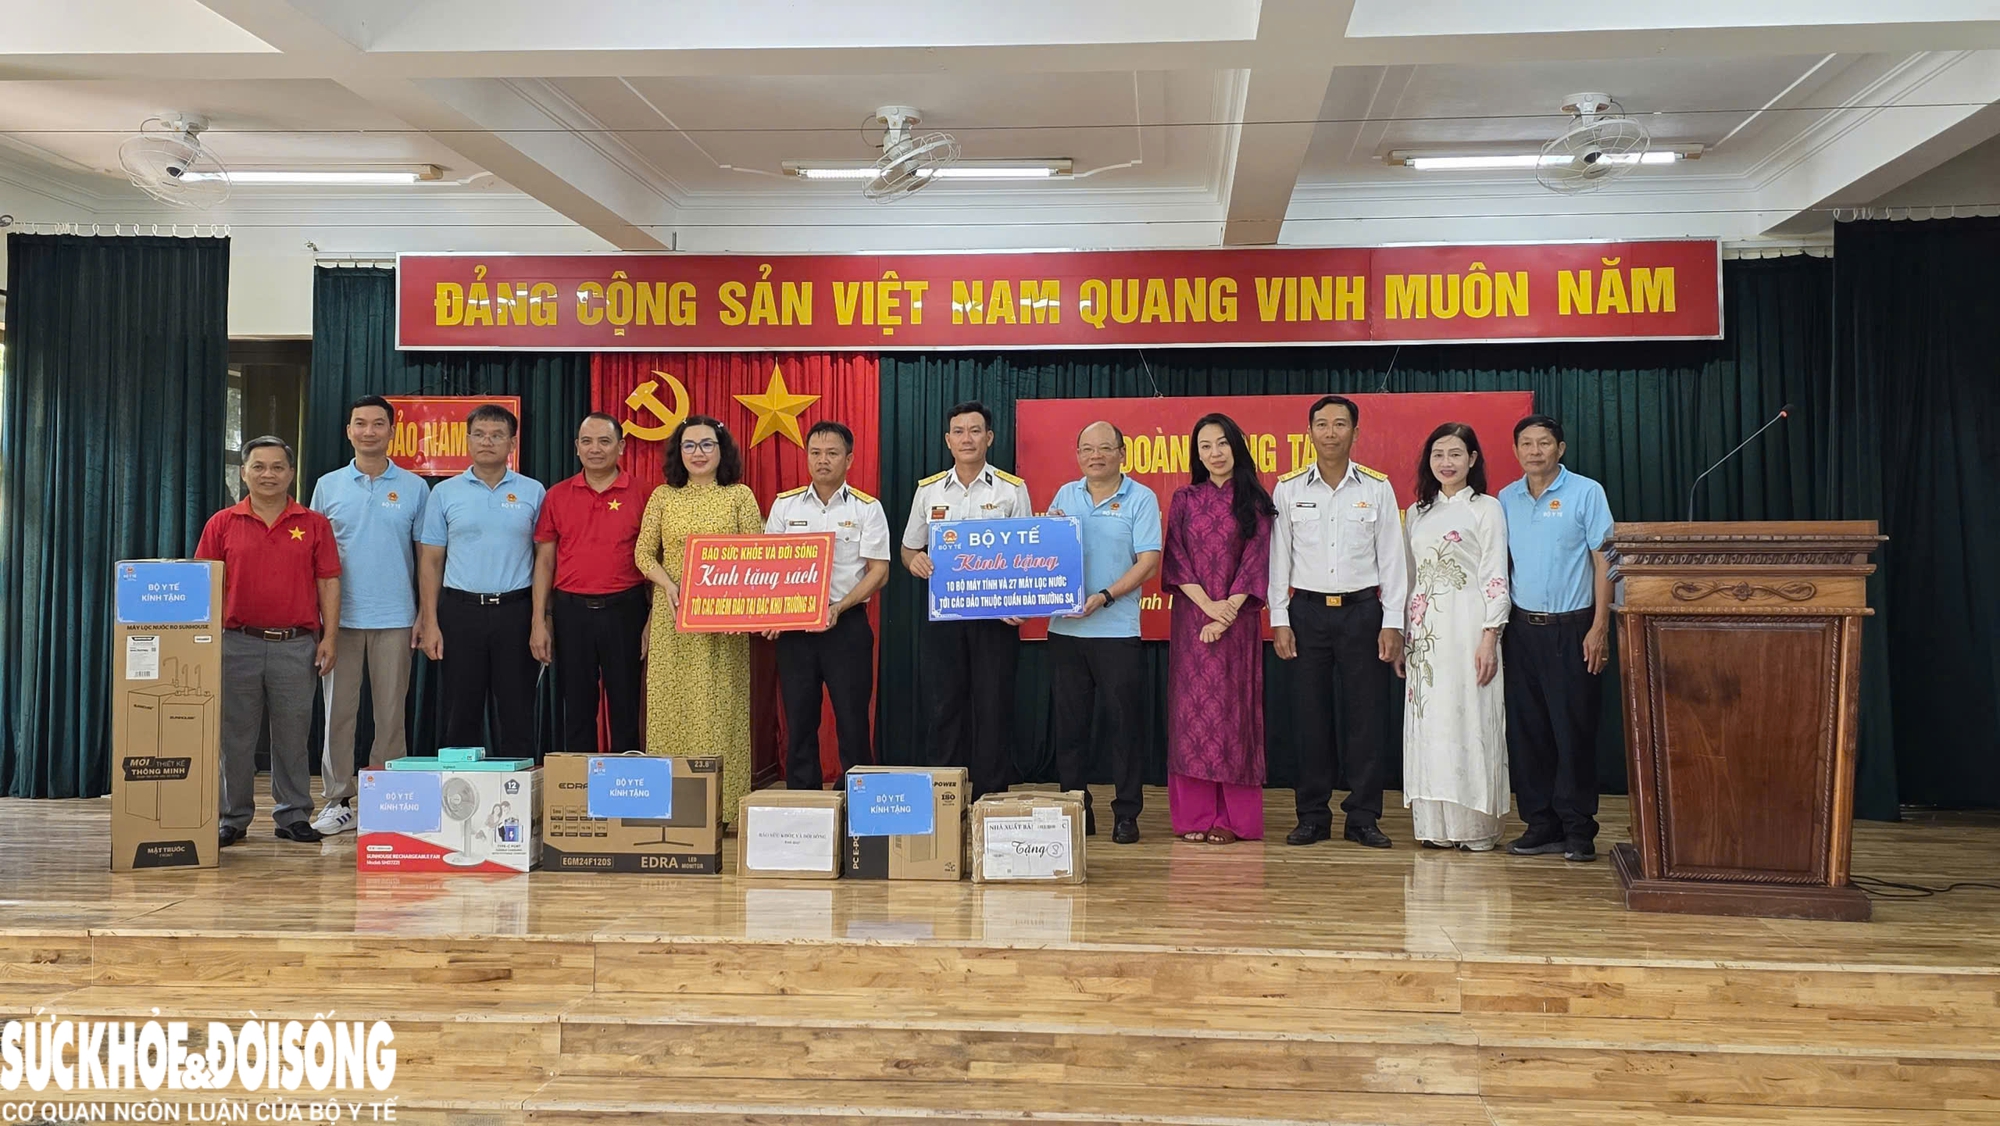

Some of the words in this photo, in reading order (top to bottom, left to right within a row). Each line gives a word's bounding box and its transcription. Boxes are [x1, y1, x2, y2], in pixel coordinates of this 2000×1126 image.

[434, 264, 558, 327] ĐẢNG
[575, 270, 697, 336] CỘNG
[719, 264, 825, 327] SẢN
[833, 270, 929, 336] VIỆT
[951, 280, 1061, 326] NAM
[1078, 277, 1238, 329] QUANG
[1254, 276, 1366, 322] VINH
[1384, 261, 1530, 320] MUÔN
[1557, 257, 1676, 316] NĂM
[424, 421, 467, 457] NAM
[969, 529, 995, 548] BỘ
[1000, 531, 1011, 545] Y
[1017, 524, 1040, 544] TẾ
[701, 545, 719, 560] BÁO
[721, 544, 739, 560] SỨC
[741, 542, 763, 560] KHỎE
[765, 544, 776, 559] VÀ
[778, 543, 792, 559] ĐỜI
[794, 541, 818, 558] SỐNG
[1013, 554, 1059, 572] tặng
[695, 564, 739, 586] Kính
[744, 567, 780, 590] tặng
[784, 562, 819, 584] sách
[946, 581, 955, 592] 10
[956, 579, 965, 593] BỘ
[966, 578, 981, 591] MÁY
[982, 577, 998, 590] TÍNH
[998, 576, 1008, 590] VÀ
[1009, 579, 1017, 589] 27
[1018, 576, 1033, 589] MÁY
[1034, 577, 1047, 590] LỌC
[1048, 574, 1067, 588] NƯỚC
[148, 583, 160, 592] BỘ
[161, 583, 168, 591] Y
[169, 582, 180, 591] TẾ
[141, 594, 161, 602] KÍNH
[163, 593, 186, 602] TẶNG
[951, 595, 965, 608] CÁC
[966, 593, 980, 608] ĐẢO
[981, 594, 1002, 609] THUỘC
[1022, 591, 1037, 605] ĐẢO
[1065, 593, 1075, 604] SA
[870, 805, 889, 814] KÍNH
[1011, 840, 1045, 858] Tặng
[641, 856, 679, 869] EDRA
